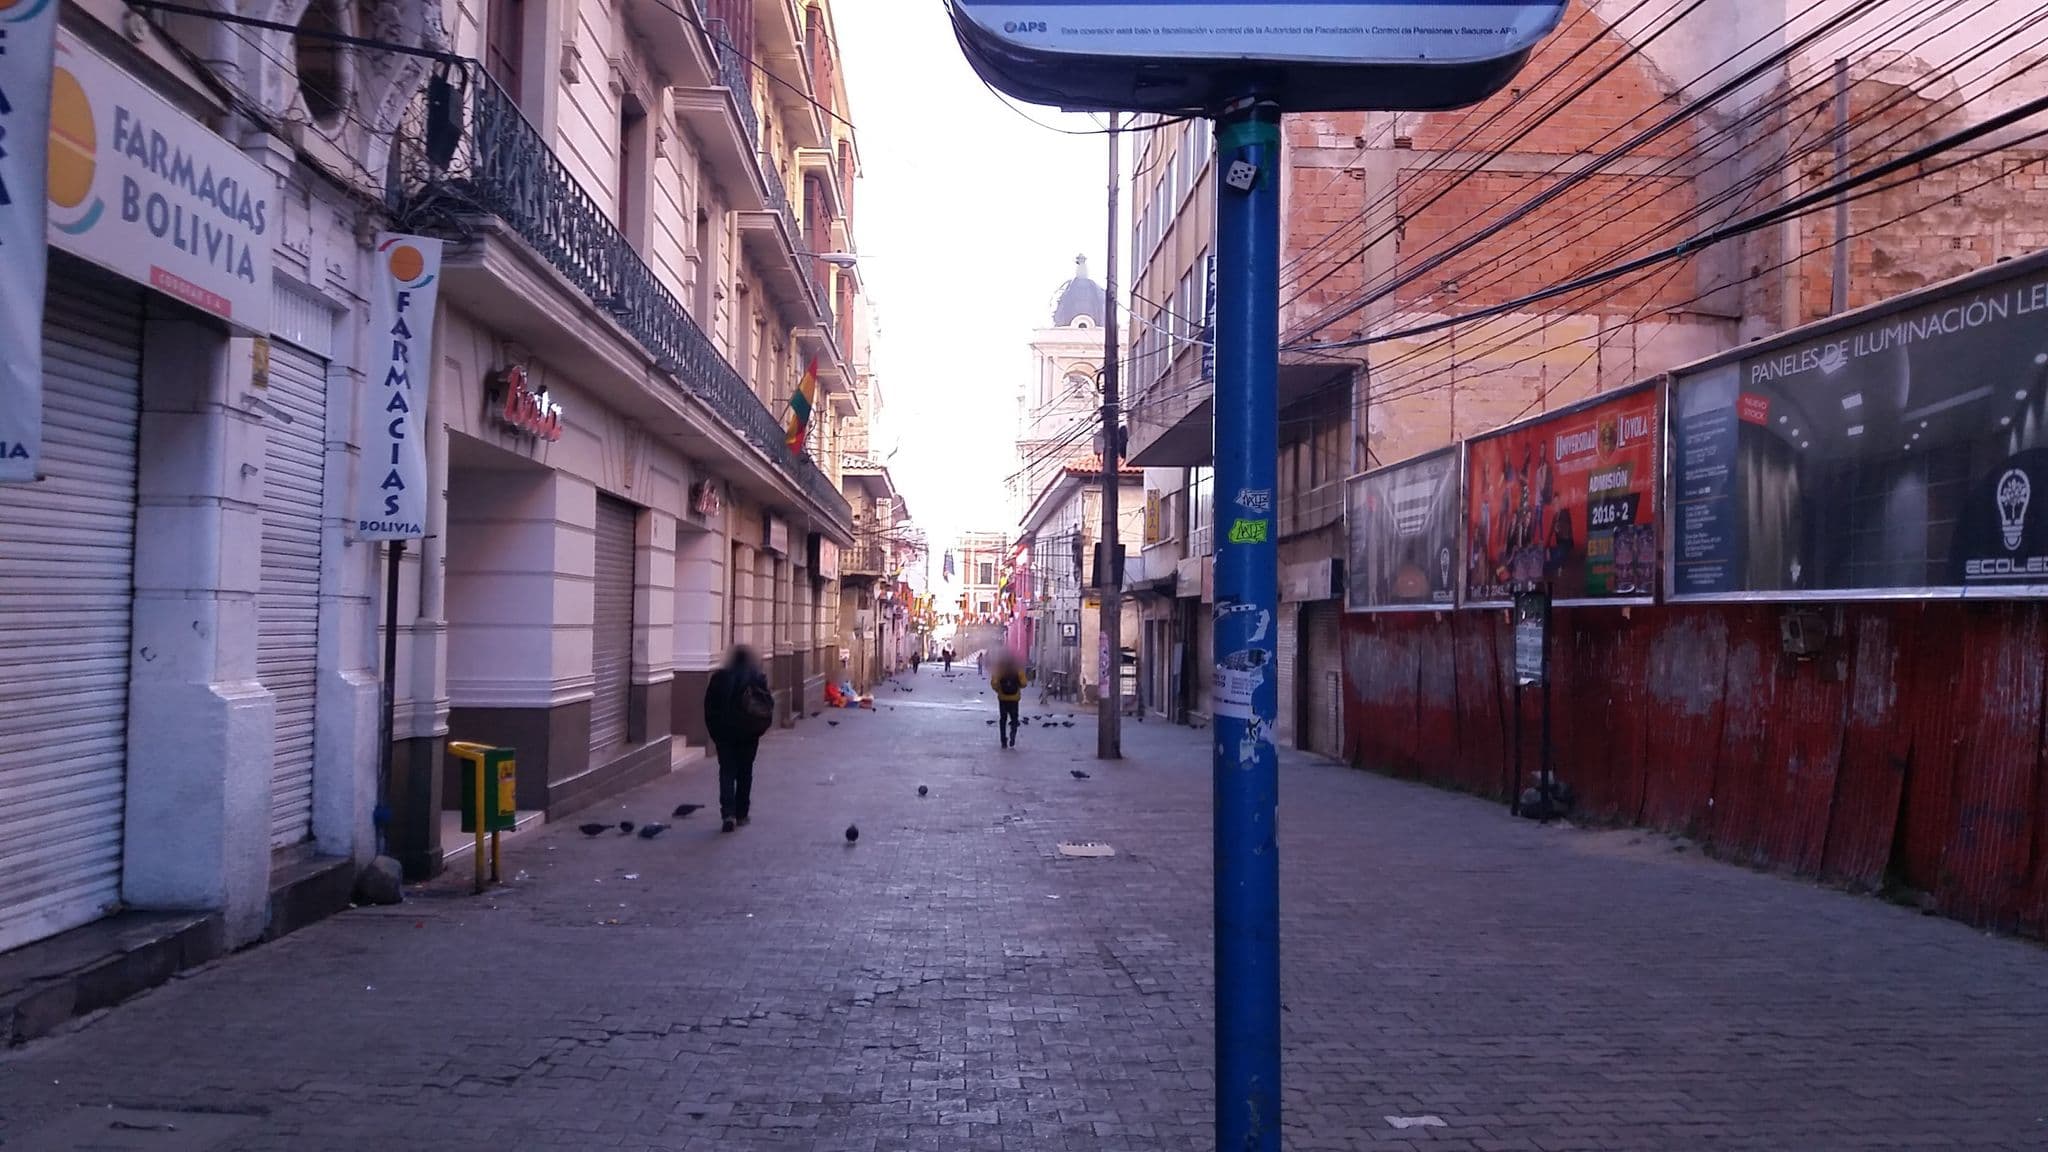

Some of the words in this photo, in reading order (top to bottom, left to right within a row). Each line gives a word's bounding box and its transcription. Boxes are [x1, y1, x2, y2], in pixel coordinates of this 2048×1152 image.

[1018, 21, 1048, 33] APS
[1215, 26, 1242, 35] control
[1243, 26, 1254, 35] de
[1255, 26, 1262, 35] la
[1264, 26, 1301, 35] Autoridad
[1303, 26, 1313, 35] de
[1314, 25, 1363, 35] Fiscalización
[1371, 26, 1400, 35] Control
[1401, 26, 1411, 35] de
[1413, 26, 1453, 35] Pensiones
[1461, 26, 1493, 36] Seguros
[112, 105, 267, 236] FARMACIAS
[121, 175, 256, 285] BOLIVIA
[1752, 348, 1819, 385] PANELES
[1824, 340, 1850, 364] DE
[1854, 293, 2008, 357] ILUMINACIÓN
[2017, 282, 2048, 315] LE
[381, 291, 412, 516] FARMACIAS
[1556, 430, 1597, 460] UNIVERSIDAD
[1619, 415, 1648, 447] LOYOLA
[1589, 466, 1628, 493] ADMISIÓN
[359, 519, 422, 535] BOLIVIA
[1592, 504, 1615, 524] 2016
[1622, 502, 1629, 520] 2
